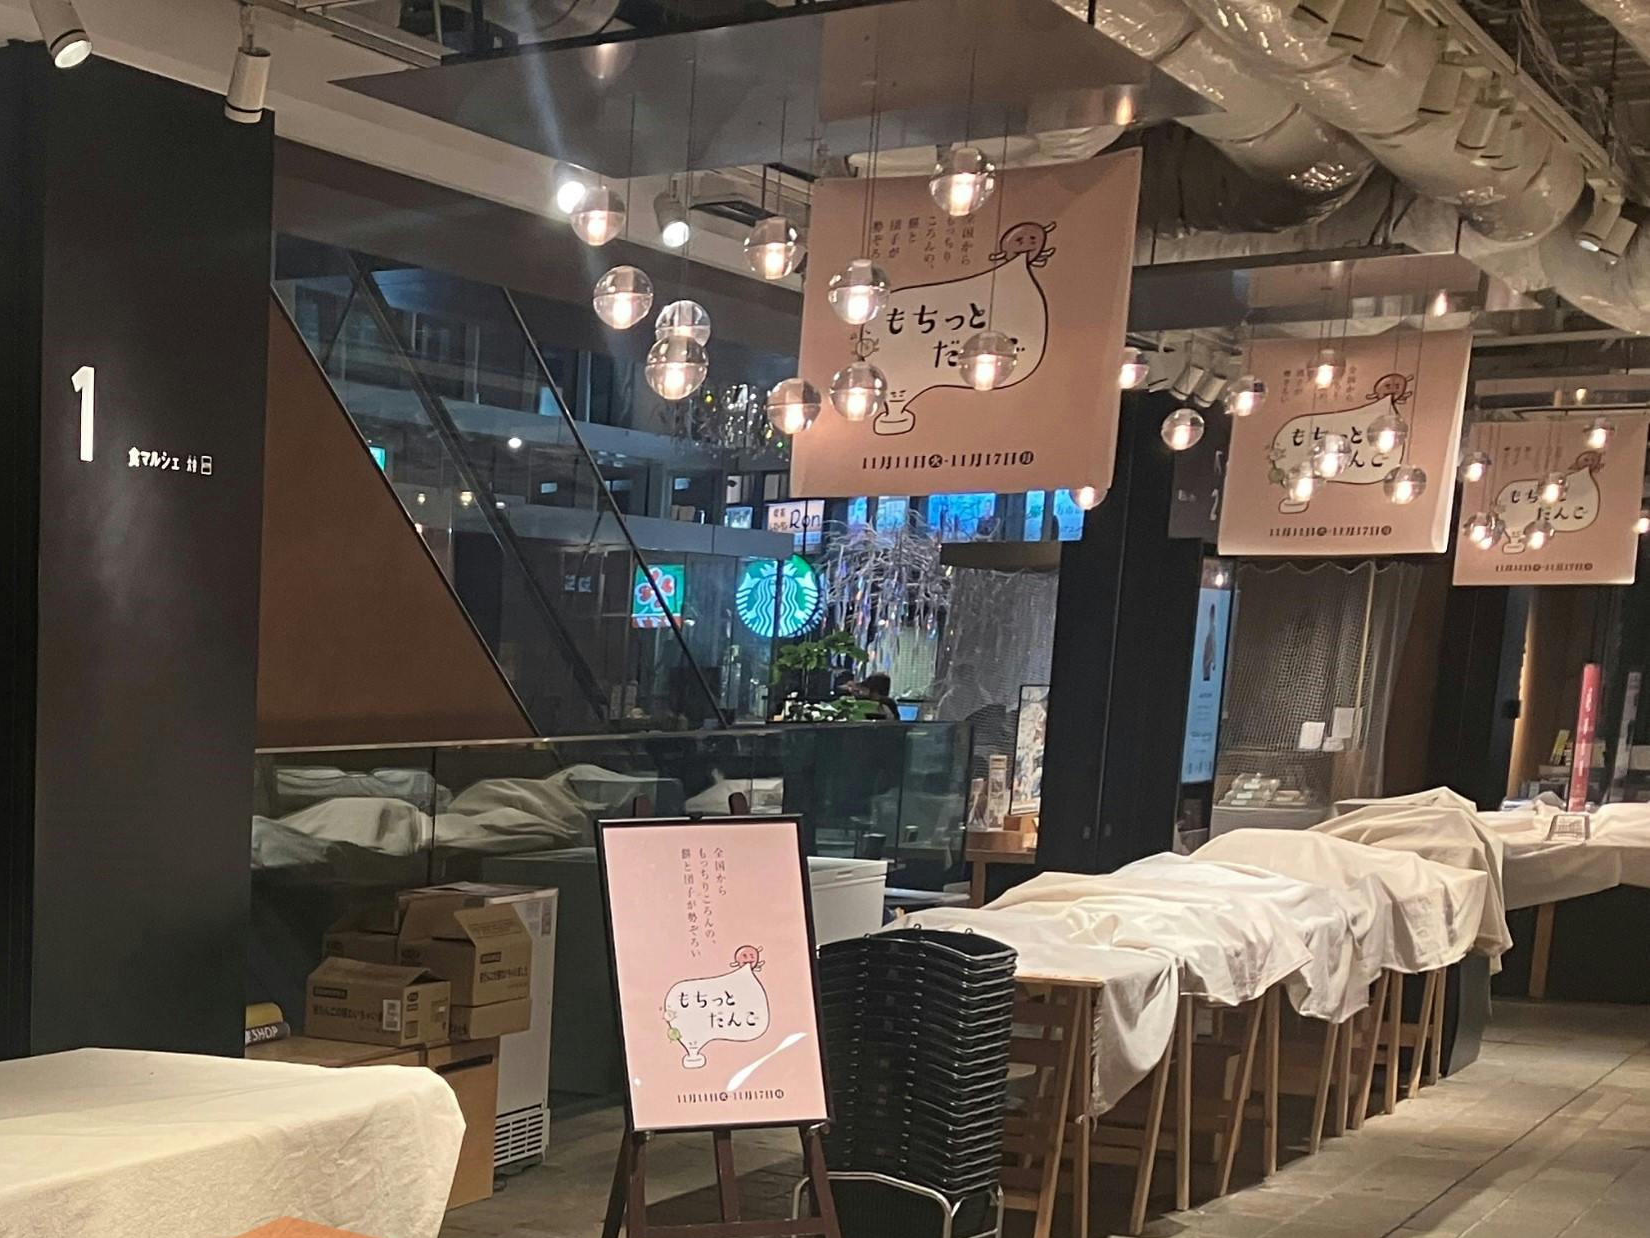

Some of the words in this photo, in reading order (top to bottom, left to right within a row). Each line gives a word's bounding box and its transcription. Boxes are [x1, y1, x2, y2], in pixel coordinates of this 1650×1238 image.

[885, 302, 988, 335] もちっと
[70, 365, 96, 462] 1
[127, 446, 180, 471] 食マルシェ
[676, 989, 738, 1009] もちっと
[709, 1010, 761, 1030] だんご
